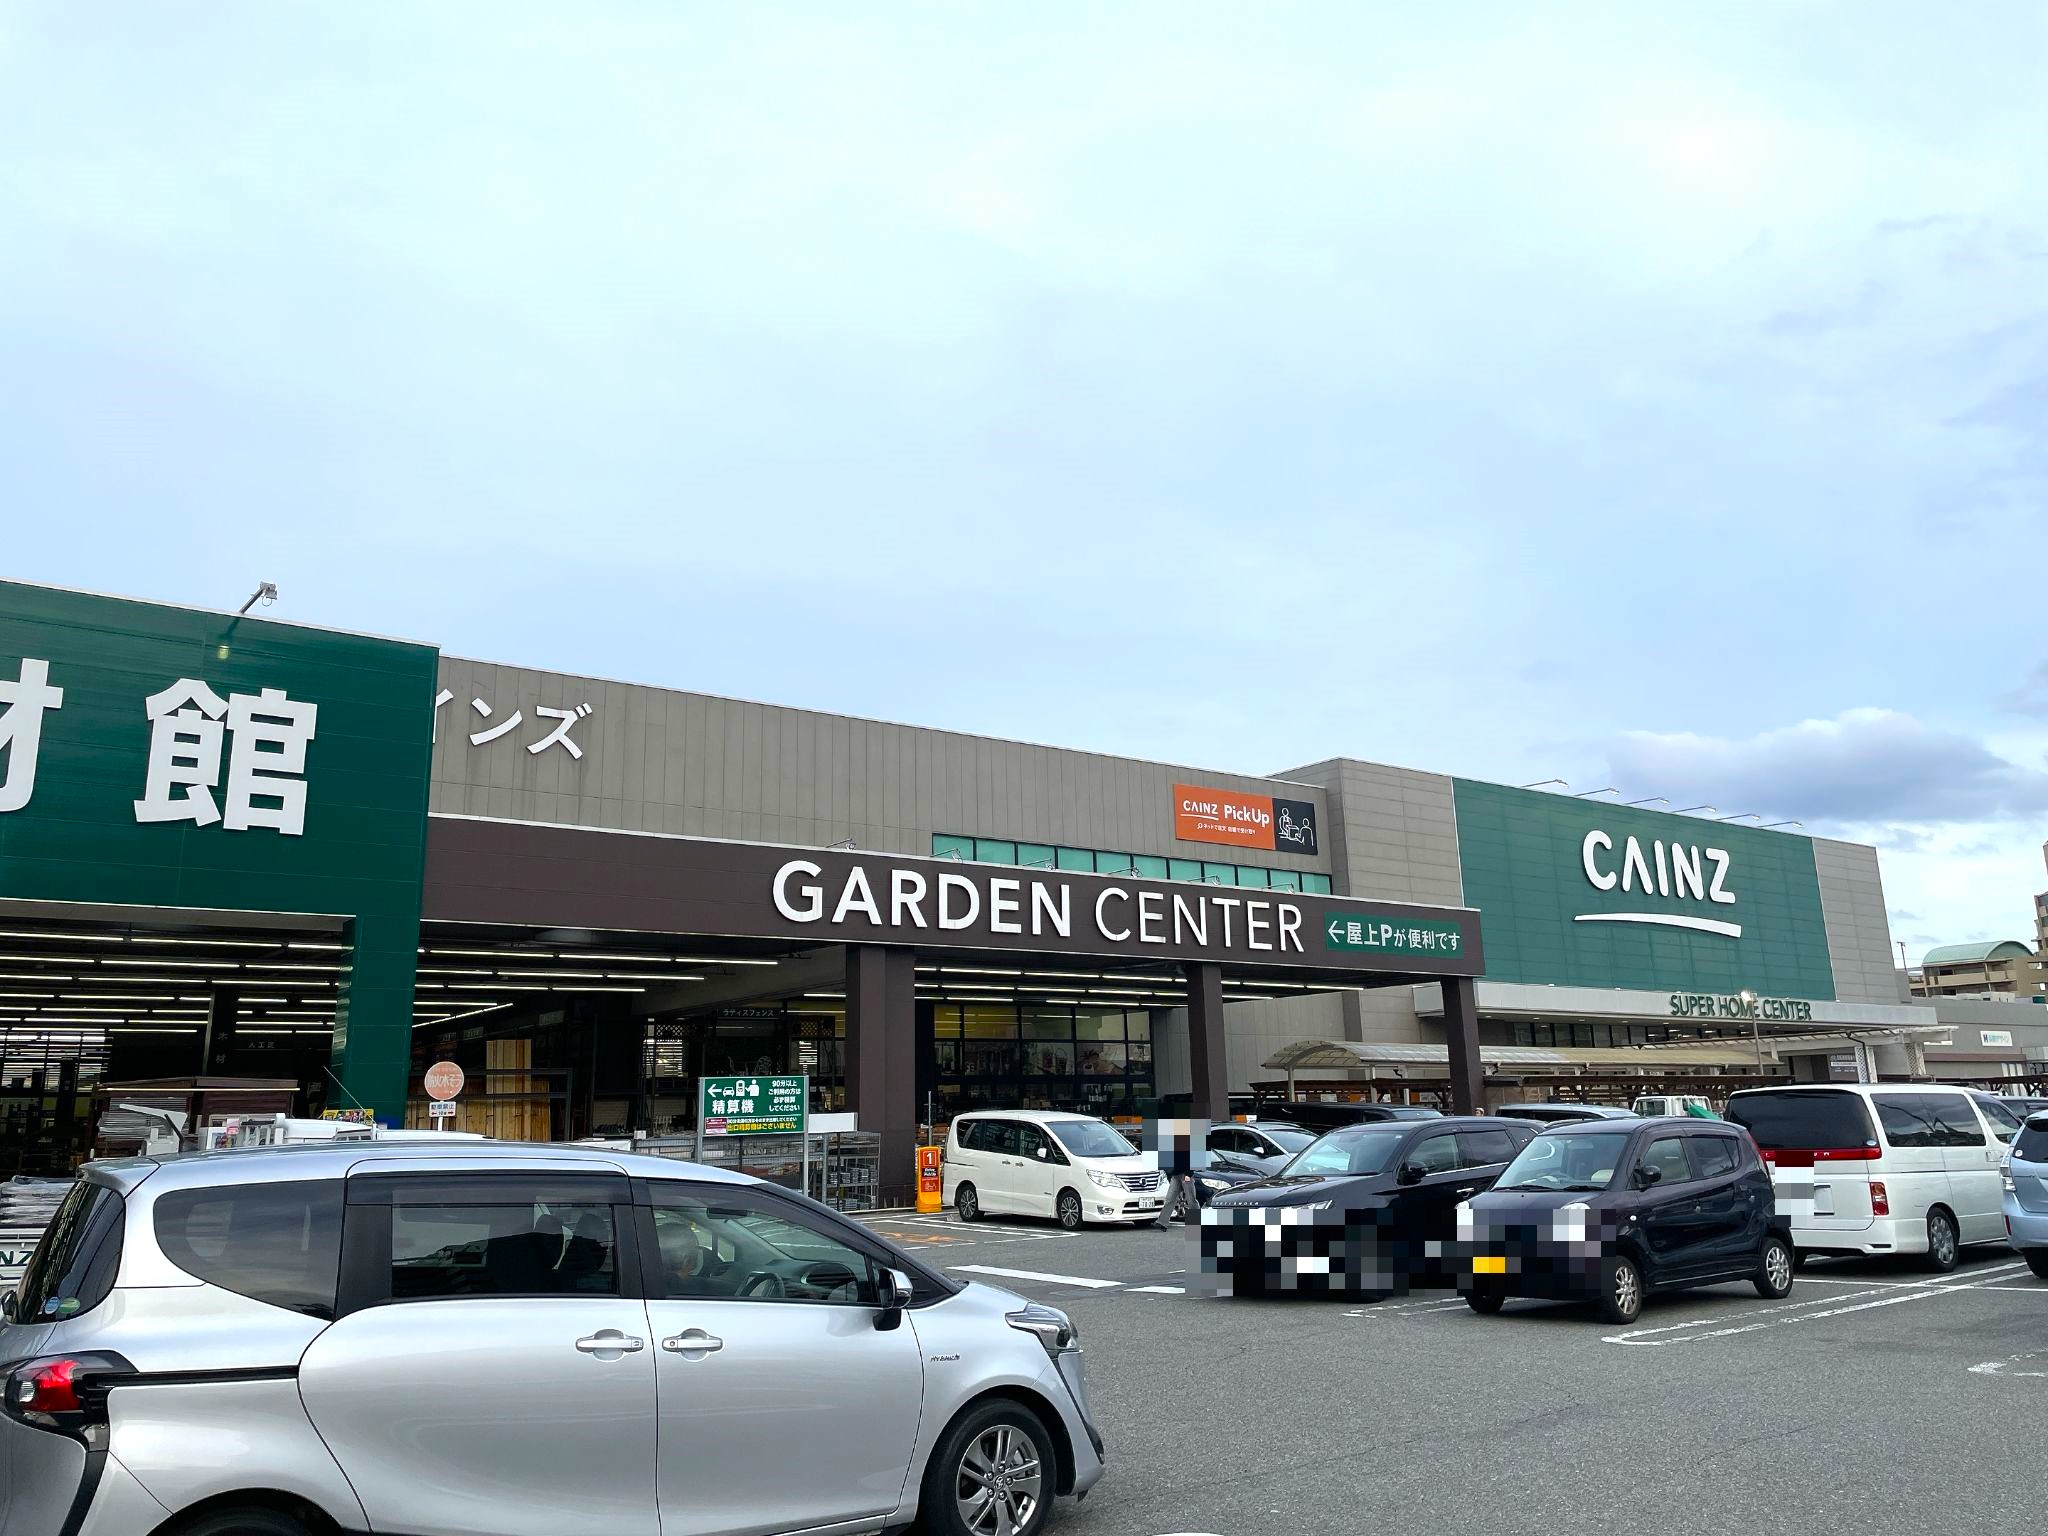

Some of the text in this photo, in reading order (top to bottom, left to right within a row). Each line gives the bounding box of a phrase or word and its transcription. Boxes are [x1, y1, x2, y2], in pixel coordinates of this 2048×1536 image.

[1183, 800, 1270, 828] CAINZ PickUp
[1582, 830, 1736, 904] CAINZ
[772, 860, 1305, 953] GARDEN CENTER
[1346, 921, 1460, 951] 屋上Pが便利です
[722, 1008, 775, 1017] ラティスフェンス
[1670, 994, 1813, 1021] SUPER HOME CENTER
[771, 1079, 798, 1087] 90分以上
[712, 1099, 755, 1115] 精算機
[768, 1104, 801, 1112] してください
[926, 1153, 932, 1164] 1
